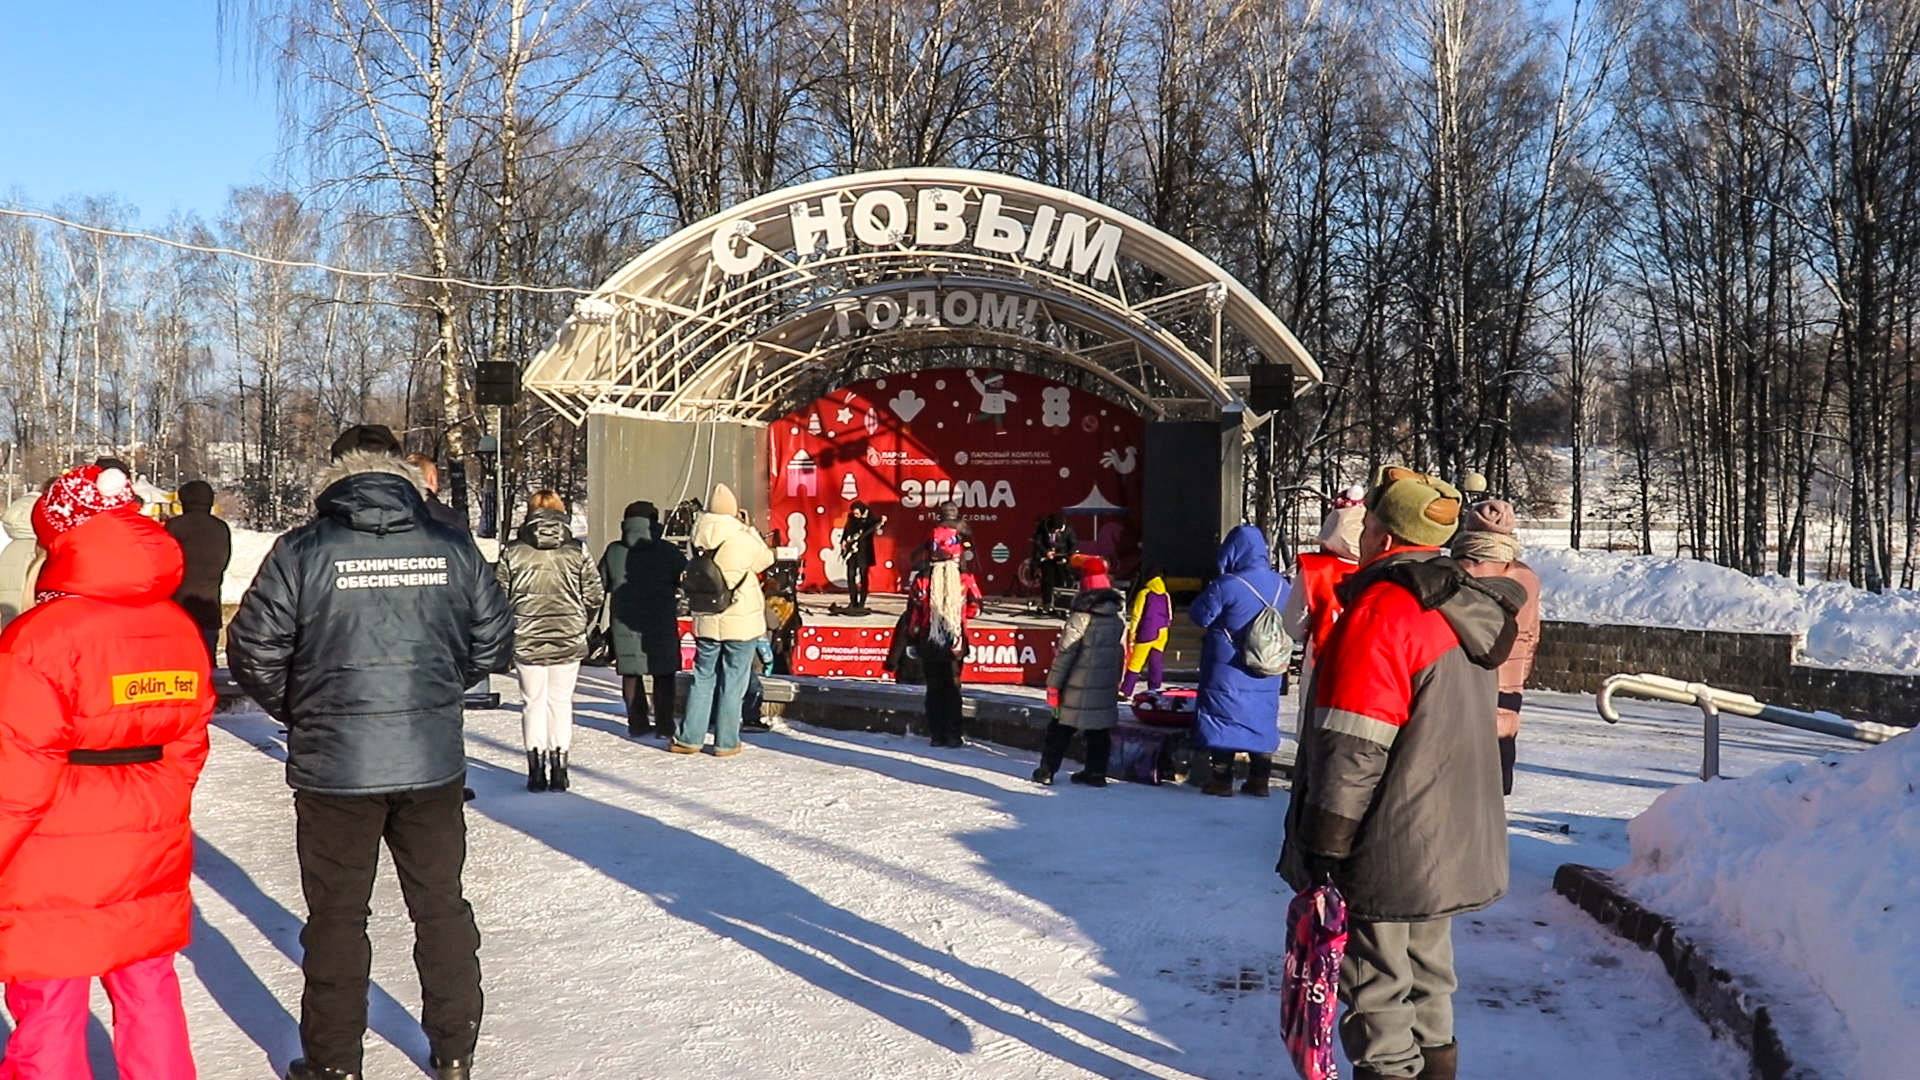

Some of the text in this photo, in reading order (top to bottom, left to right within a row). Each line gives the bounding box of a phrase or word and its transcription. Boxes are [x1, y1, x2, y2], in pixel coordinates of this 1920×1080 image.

[711, 188, 1123, 281] С НОВЫМ
[834, 290, 1039, 337] ГОДОМ!
[1011, 451, 1050, 459] КОМПЛЕКС
[900, 479, 1016, 508] ЗИМА
[927, 511, 998, 521] Посковье
[334, 557, 448, 573] ТЕХНИЧЕСКОЕ
[335, 572, 448, 590] ОБЕСПЕЧЕНИЕ
[821, 646, 858, 655] ПАРКОВЫЙ
[962, 645, 1037, 664] ЗИМА
[125, 676, 193, 700] @klin_fest
